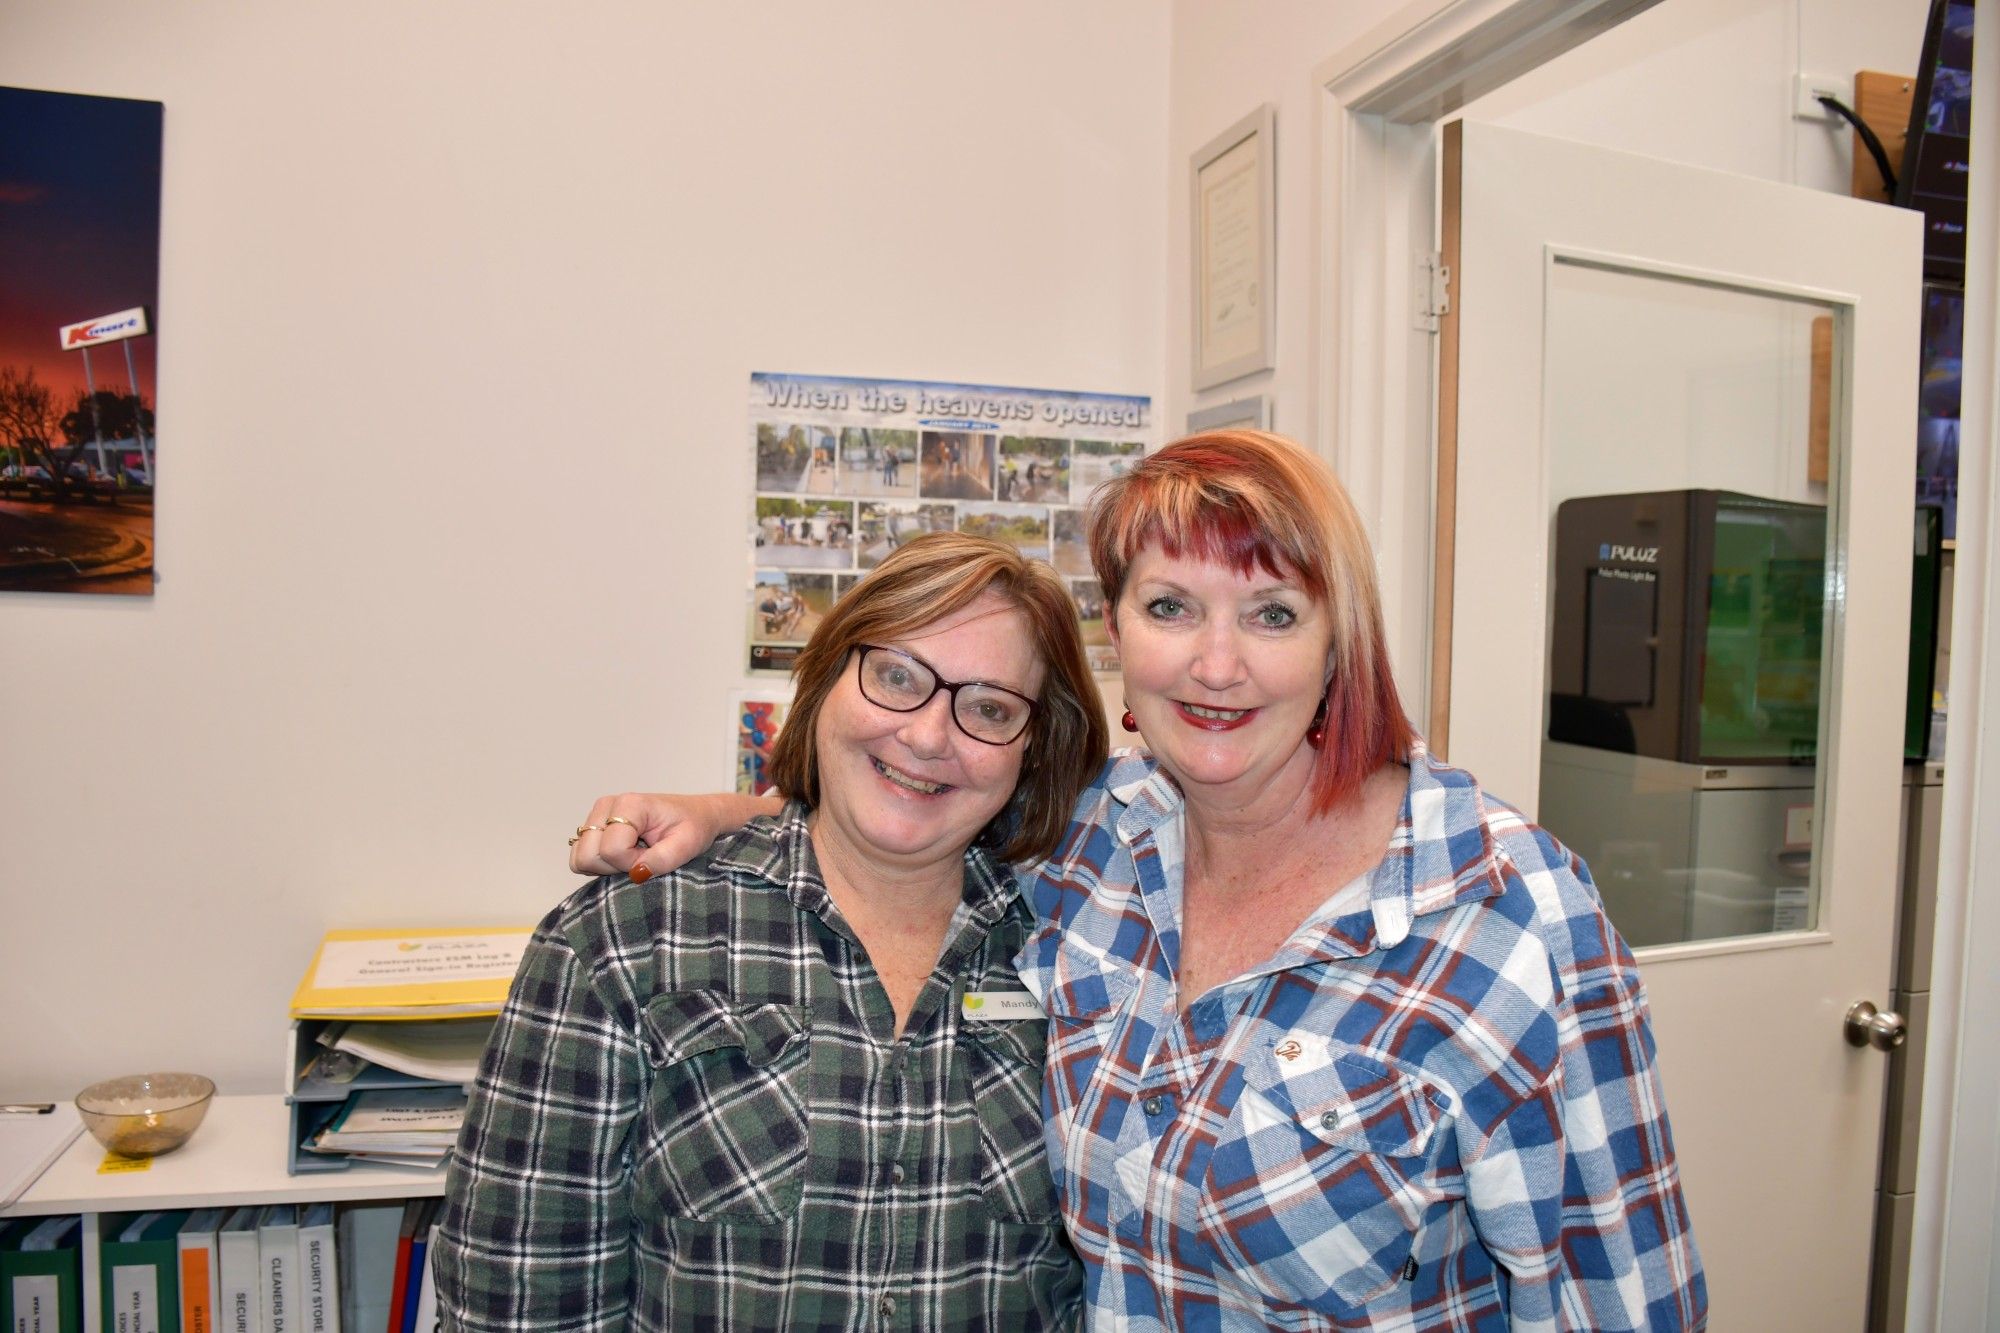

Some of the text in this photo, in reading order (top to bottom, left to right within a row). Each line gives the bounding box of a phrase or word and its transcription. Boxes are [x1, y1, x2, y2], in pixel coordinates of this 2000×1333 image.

[68, 319, 137, 345] Kmart
[764, 380, 1143, 428] When the heavens opened
[1610, 544, 1659, 563] PULUZ
[1000, 1000, 1038, 1009] Mandy
[310, 1240, 322, 1294] SECURITY
[271, 1257, 283, 1316] CLEANERS
